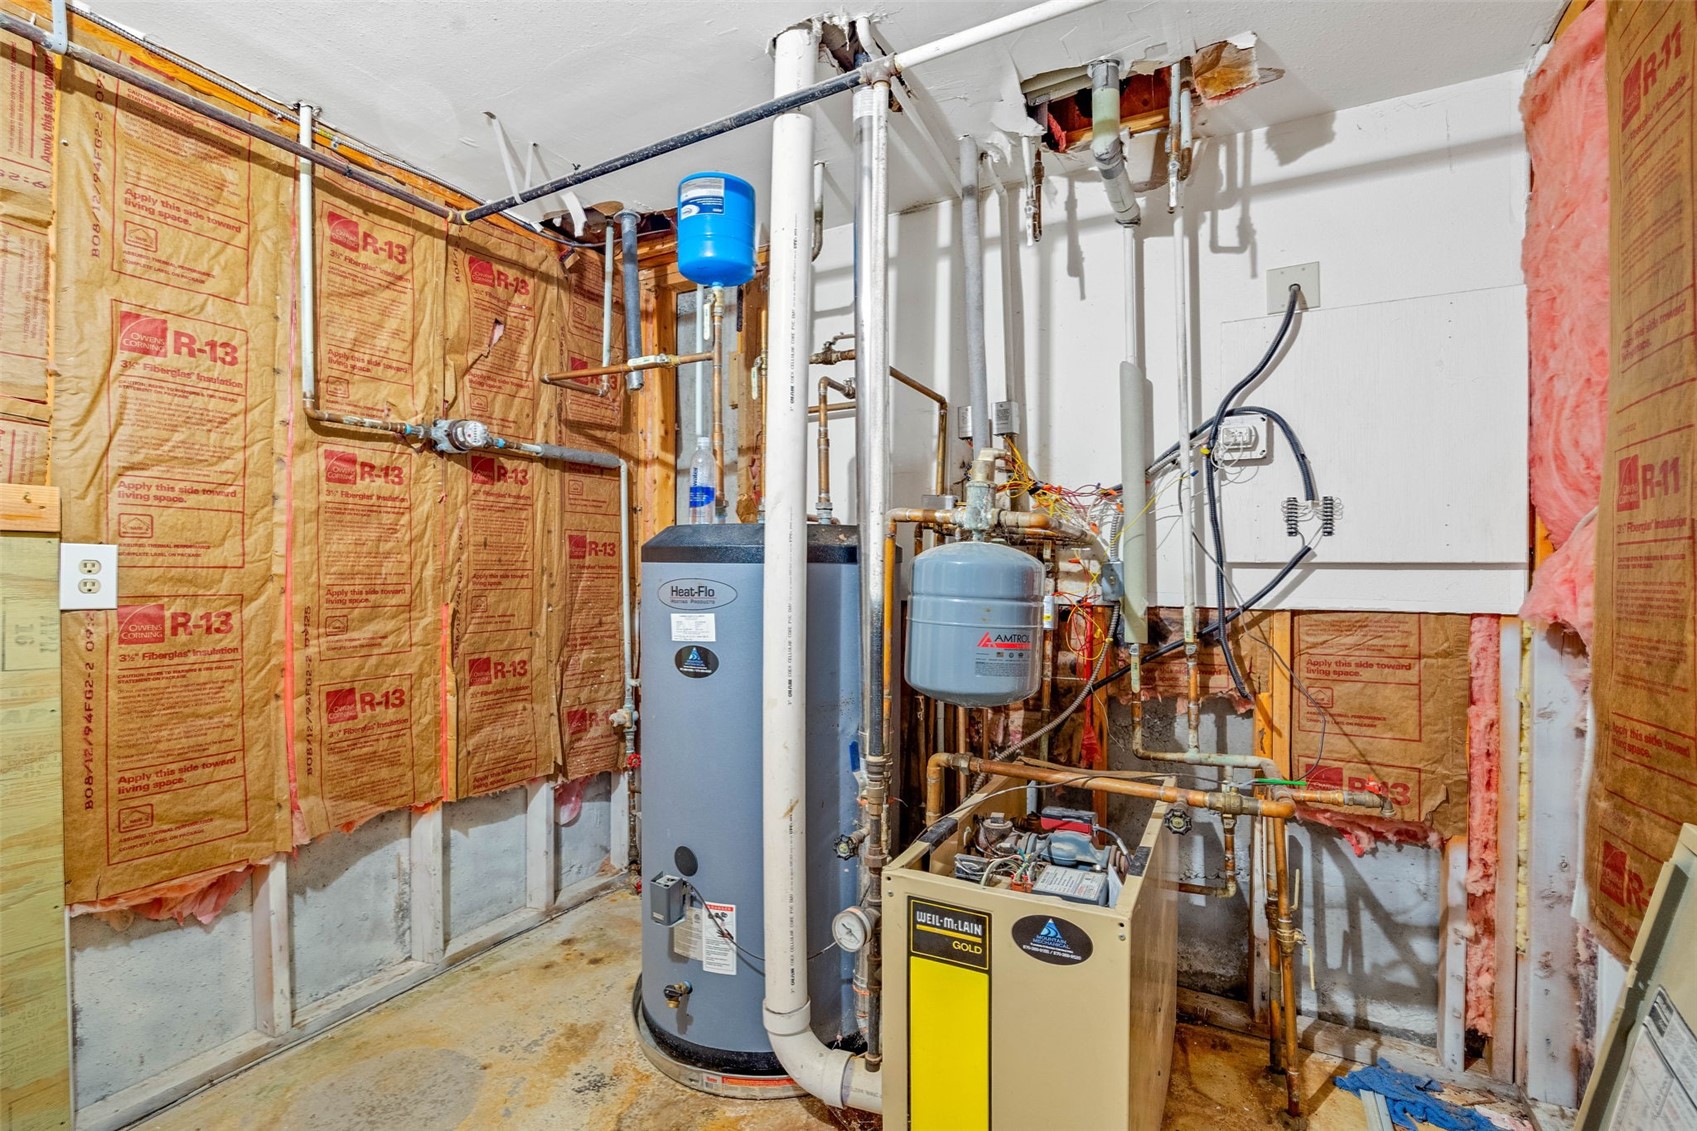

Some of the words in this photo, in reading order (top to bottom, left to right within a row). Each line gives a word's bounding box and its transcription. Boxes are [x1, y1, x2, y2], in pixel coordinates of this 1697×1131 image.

[1643, 20, 1681, 96] R-11
[124, 188, 158, 206] Apply
[160, 200, 181, 213] this
[183, 208, 205, 221] side
[206, 216, 241, 233] toward
[124, 197, 155, 216] living
[158, 210, 192, 226] space.
[362, 231, 407, 265] R-13
[496, 270, 530, 296] R-13
[123, 338, 166, 353] CORNING
[130, 332, 165, 345] OWENS
[173, 330, 239, 367] R-13
[328, 349, 350, 360] Apply
[197, 373, 243, 389] Insulation
[360, 461, 404, 486] R-13
[496, 465, 529, 486] R-13
[1641, 457, 1680, 500] R-11
[118, 480, 152, 492] Apply
[156, 483, 176, 493] this
[178, 486, 199, 495] side
[201, 489, 237, 498] toward
[118, 491, 150, 501] living
[153, 495, 187, 503] space.
[376, 495, 408, 503] Insulation
[588, 540, 616, 557] R-13
[326, 589, 348, 597] Apply
[365, 588, 379, 596] side
[671, 585, 715, 598] Heat-Flo
[85, 612, 95, 652] 09:2
[129, 624, 163, 632] OWENS
[171, 611, 234, 637] R-13
[121, 632, 163, 640] CORNING
[994, 634, 1031, 643] AMTROL
[192, 647, 239, 657] Insulation
[493, 660, 528, 680] R-13
[1306, 659, 1332, 667] Apply
[1306, 667, 1330, 676] living
[360, 688, 405, 713] R-13
[377, 719, 408, 729] Insulation
[84, 663, 95, 810] B08/12/94FG2-2
[1644, 733, 1663, 748] side
[118, 773, 152, 784] Apply
[155, 768, 176, 778] this
[178, 764, 199, 774] side
[201, 756, 236, 770] toward
[118, 782, 150, 795] living
[153, 777, 187, 788] space.
[953, 941, 982, 954] GOLD
